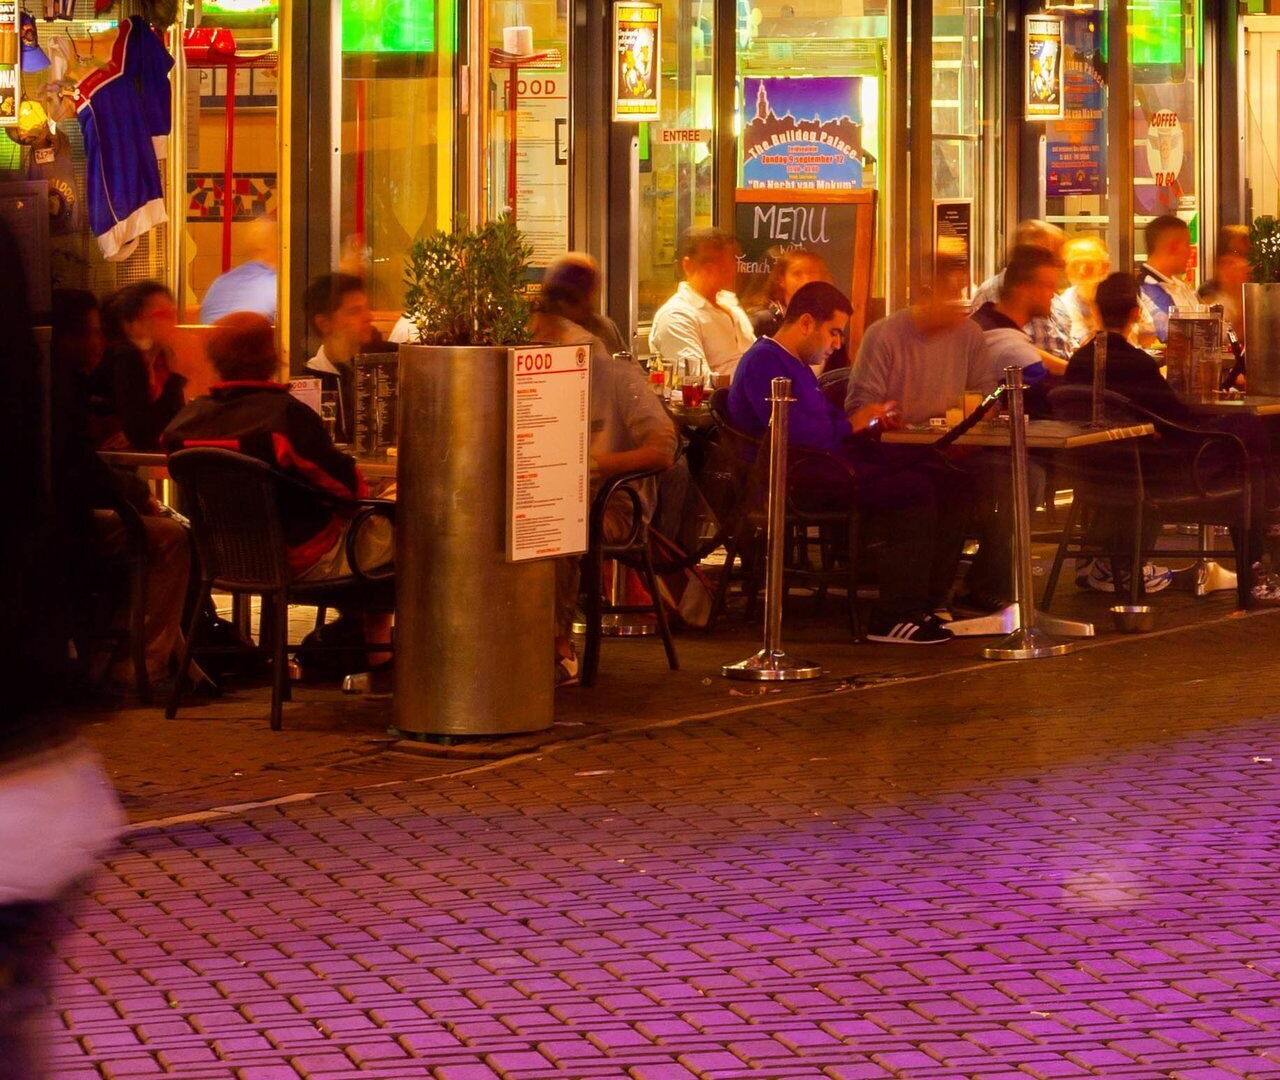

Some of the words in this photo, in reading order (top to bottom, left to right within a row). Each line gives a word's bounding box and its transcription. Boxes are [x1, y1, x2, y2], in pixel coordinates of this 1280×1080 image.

[1151, 113, 1178, 127] COFFEE
[663, 131, 700, 142] ENTREE
[748, 139, 770, 159] The
[771, 129, 817, 146] Bulldog
[820, 131, 858, 159] Palace
[1155, 172, 1164, 187] TO
[1165, 172, 1175, 187] GO
[517, 353, 552, 371] FOOD
